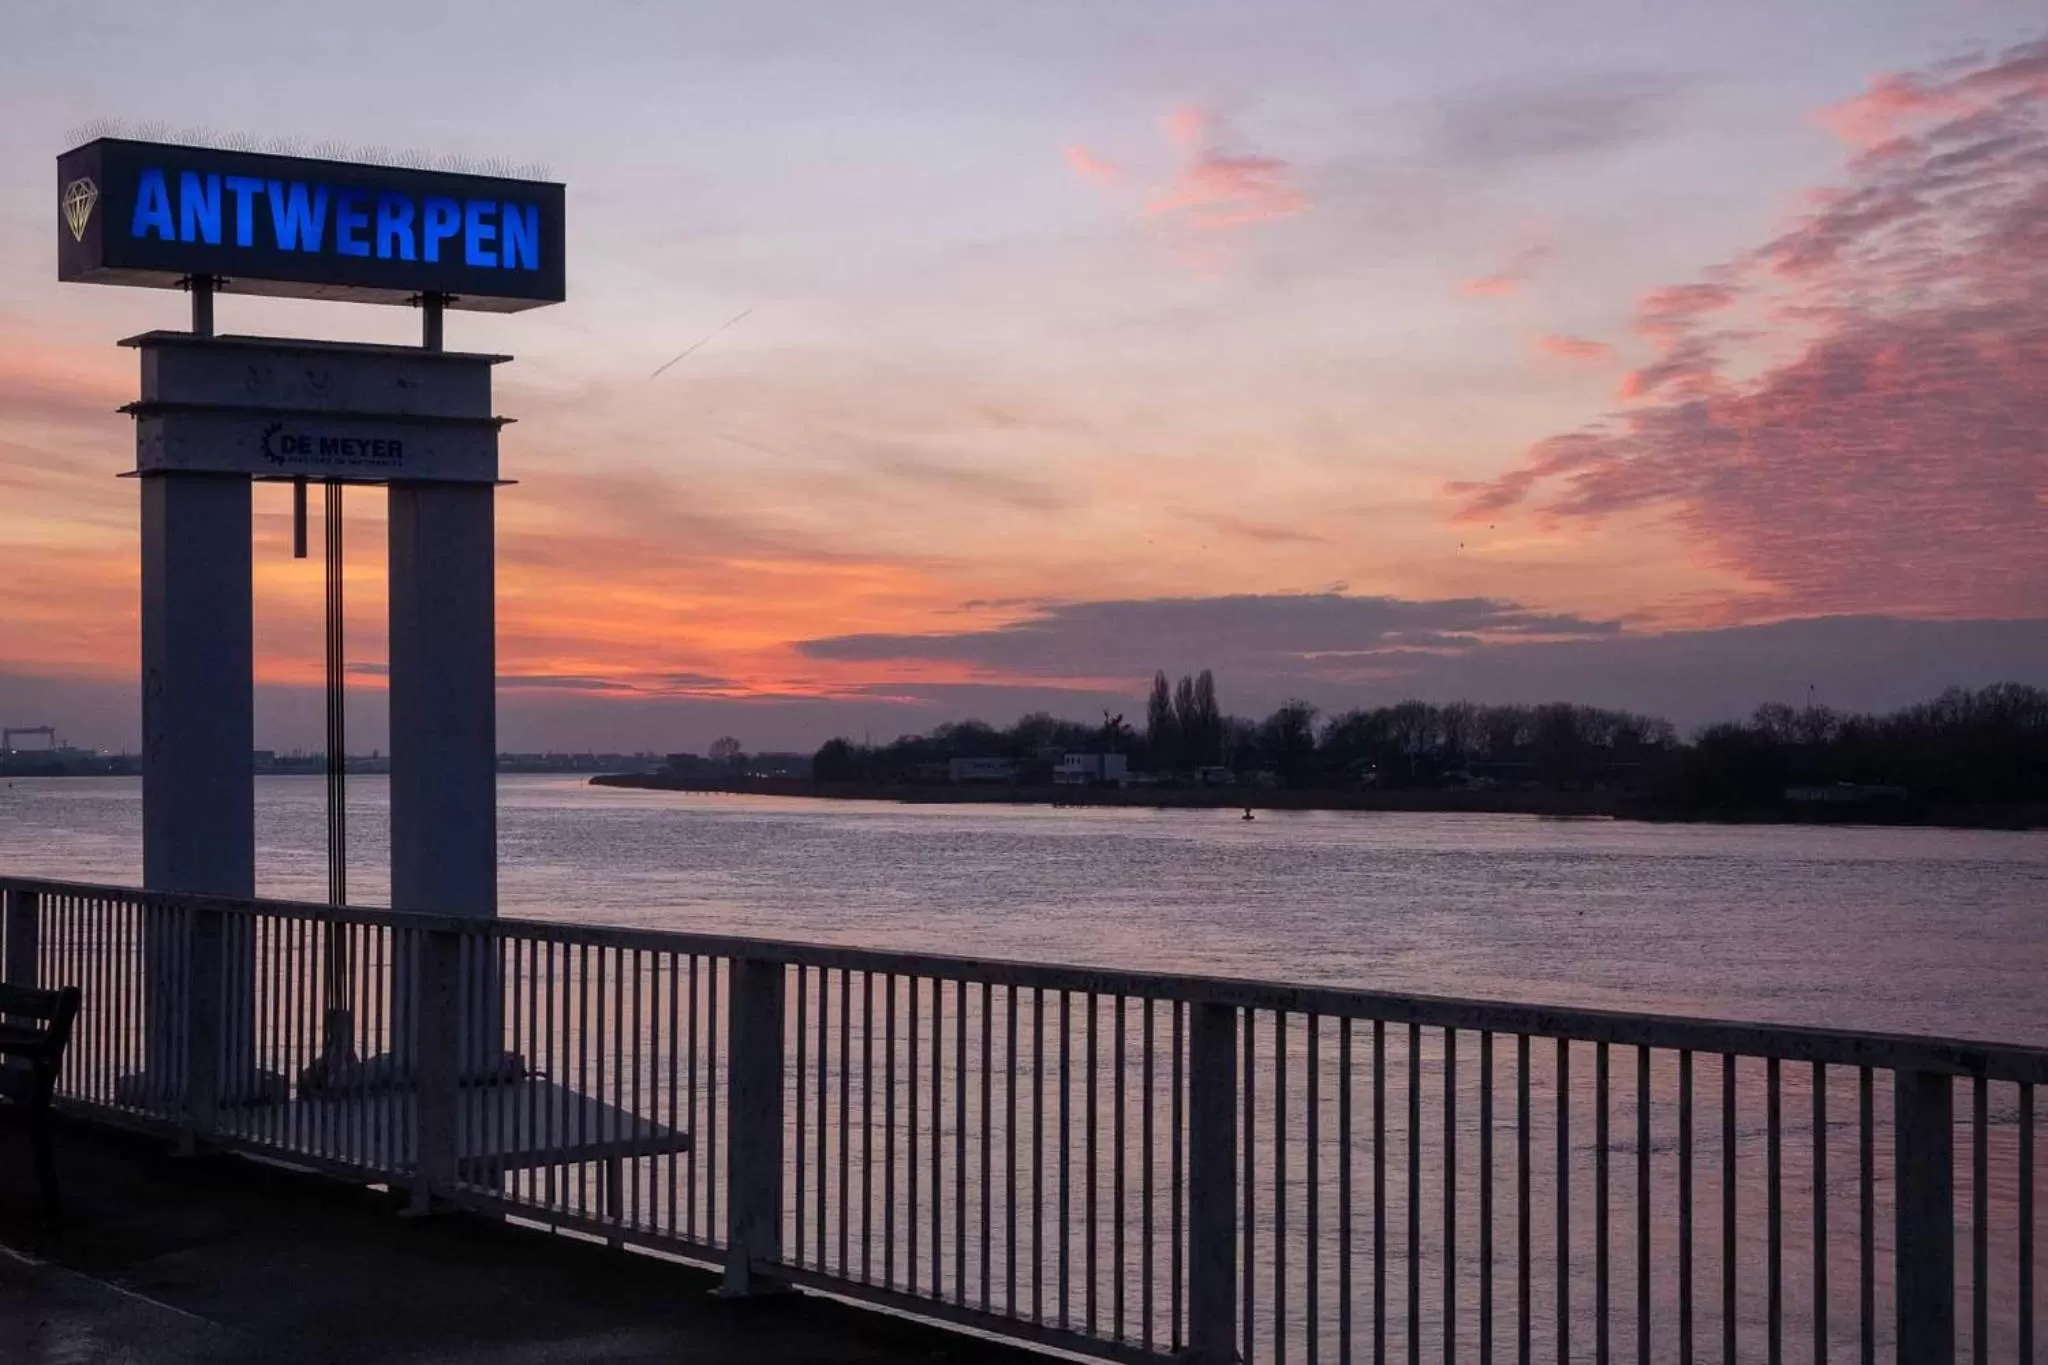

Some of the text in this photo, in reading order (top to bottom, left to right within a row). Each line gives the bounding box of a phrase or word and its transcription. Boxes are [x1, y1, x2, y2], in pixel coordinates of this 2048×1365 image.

[131, 167, 540, 271] ANTWERPEN
[281, 434, 403, 458] DE MEYER
